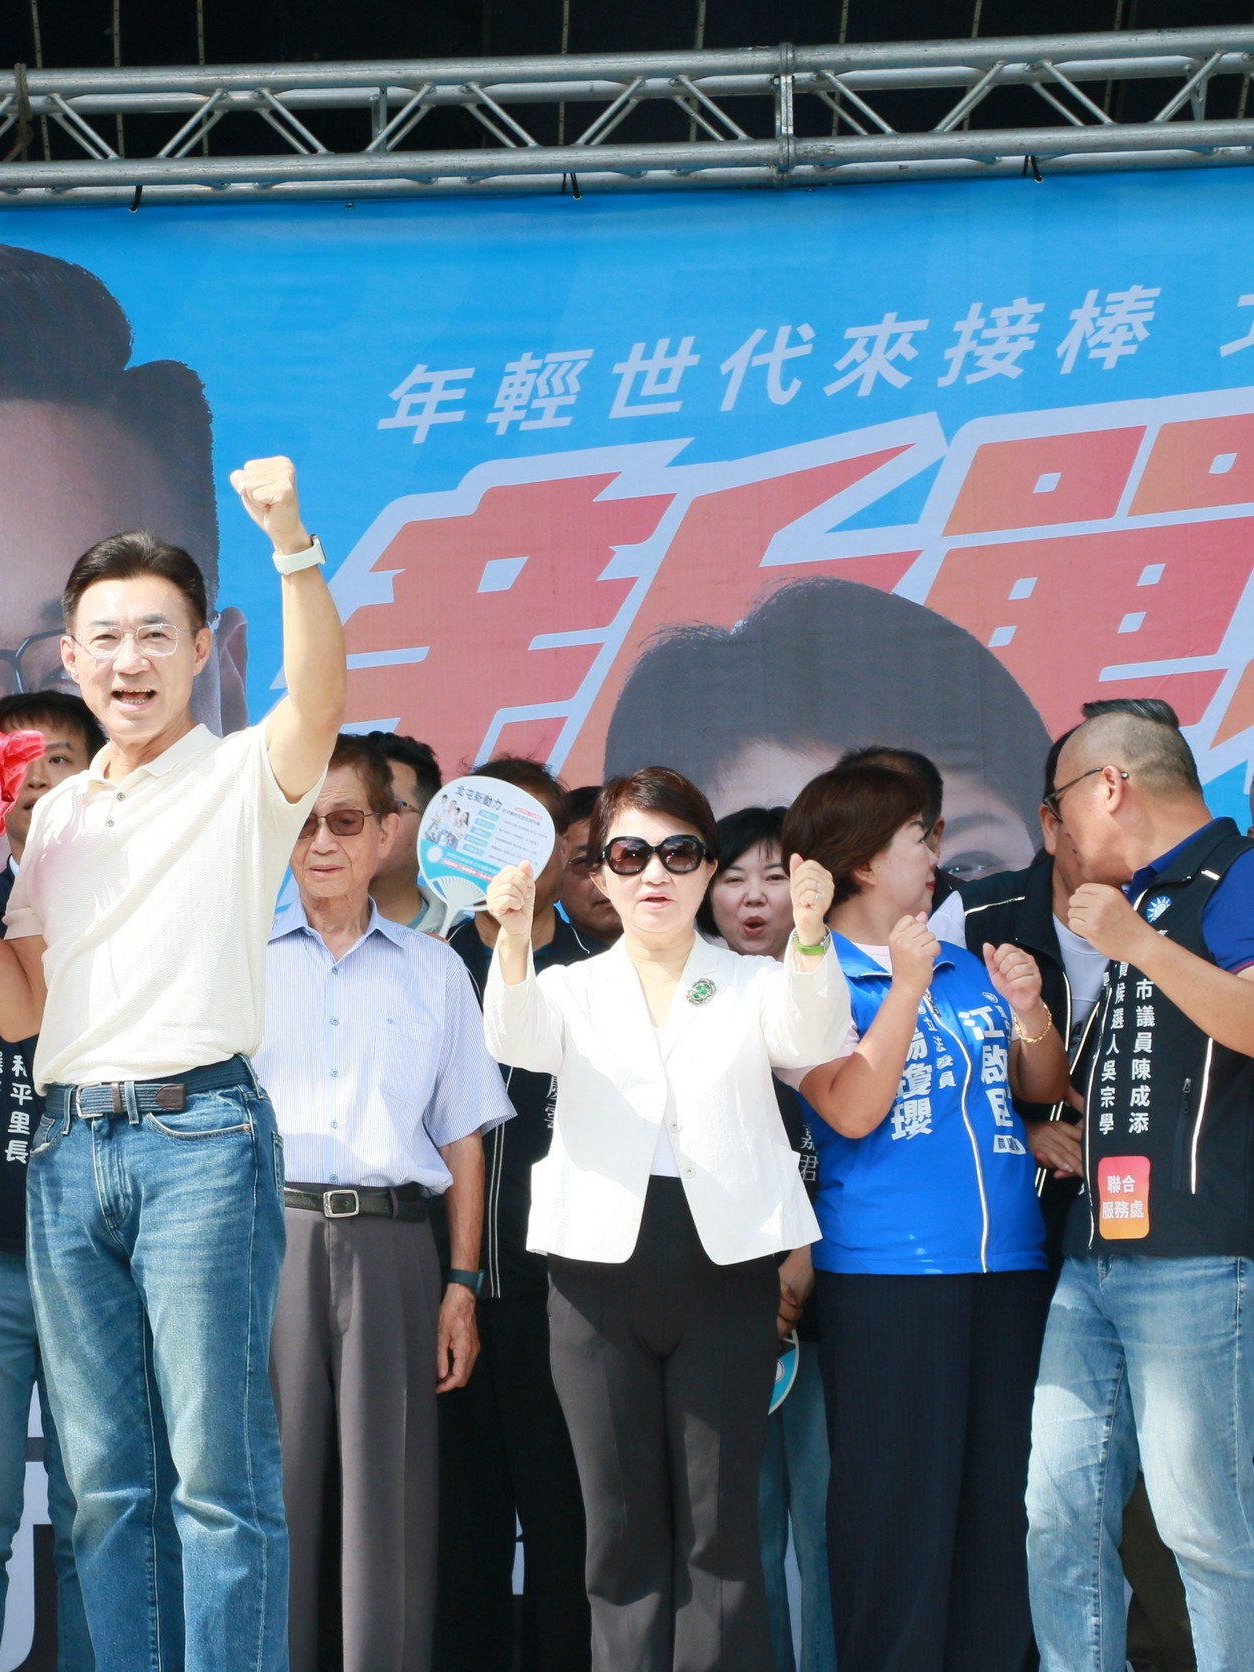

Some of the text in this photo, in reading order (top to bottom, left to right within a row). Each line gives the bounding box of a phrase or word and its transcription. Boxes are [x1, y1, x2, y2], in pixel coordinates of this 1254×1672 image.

[378, 285, 1162, 444] 年輕世代來接棒
[1107, 1175, 1136, 1193] 聯合
[1102, 1200, 1145, 1219] 服務處
